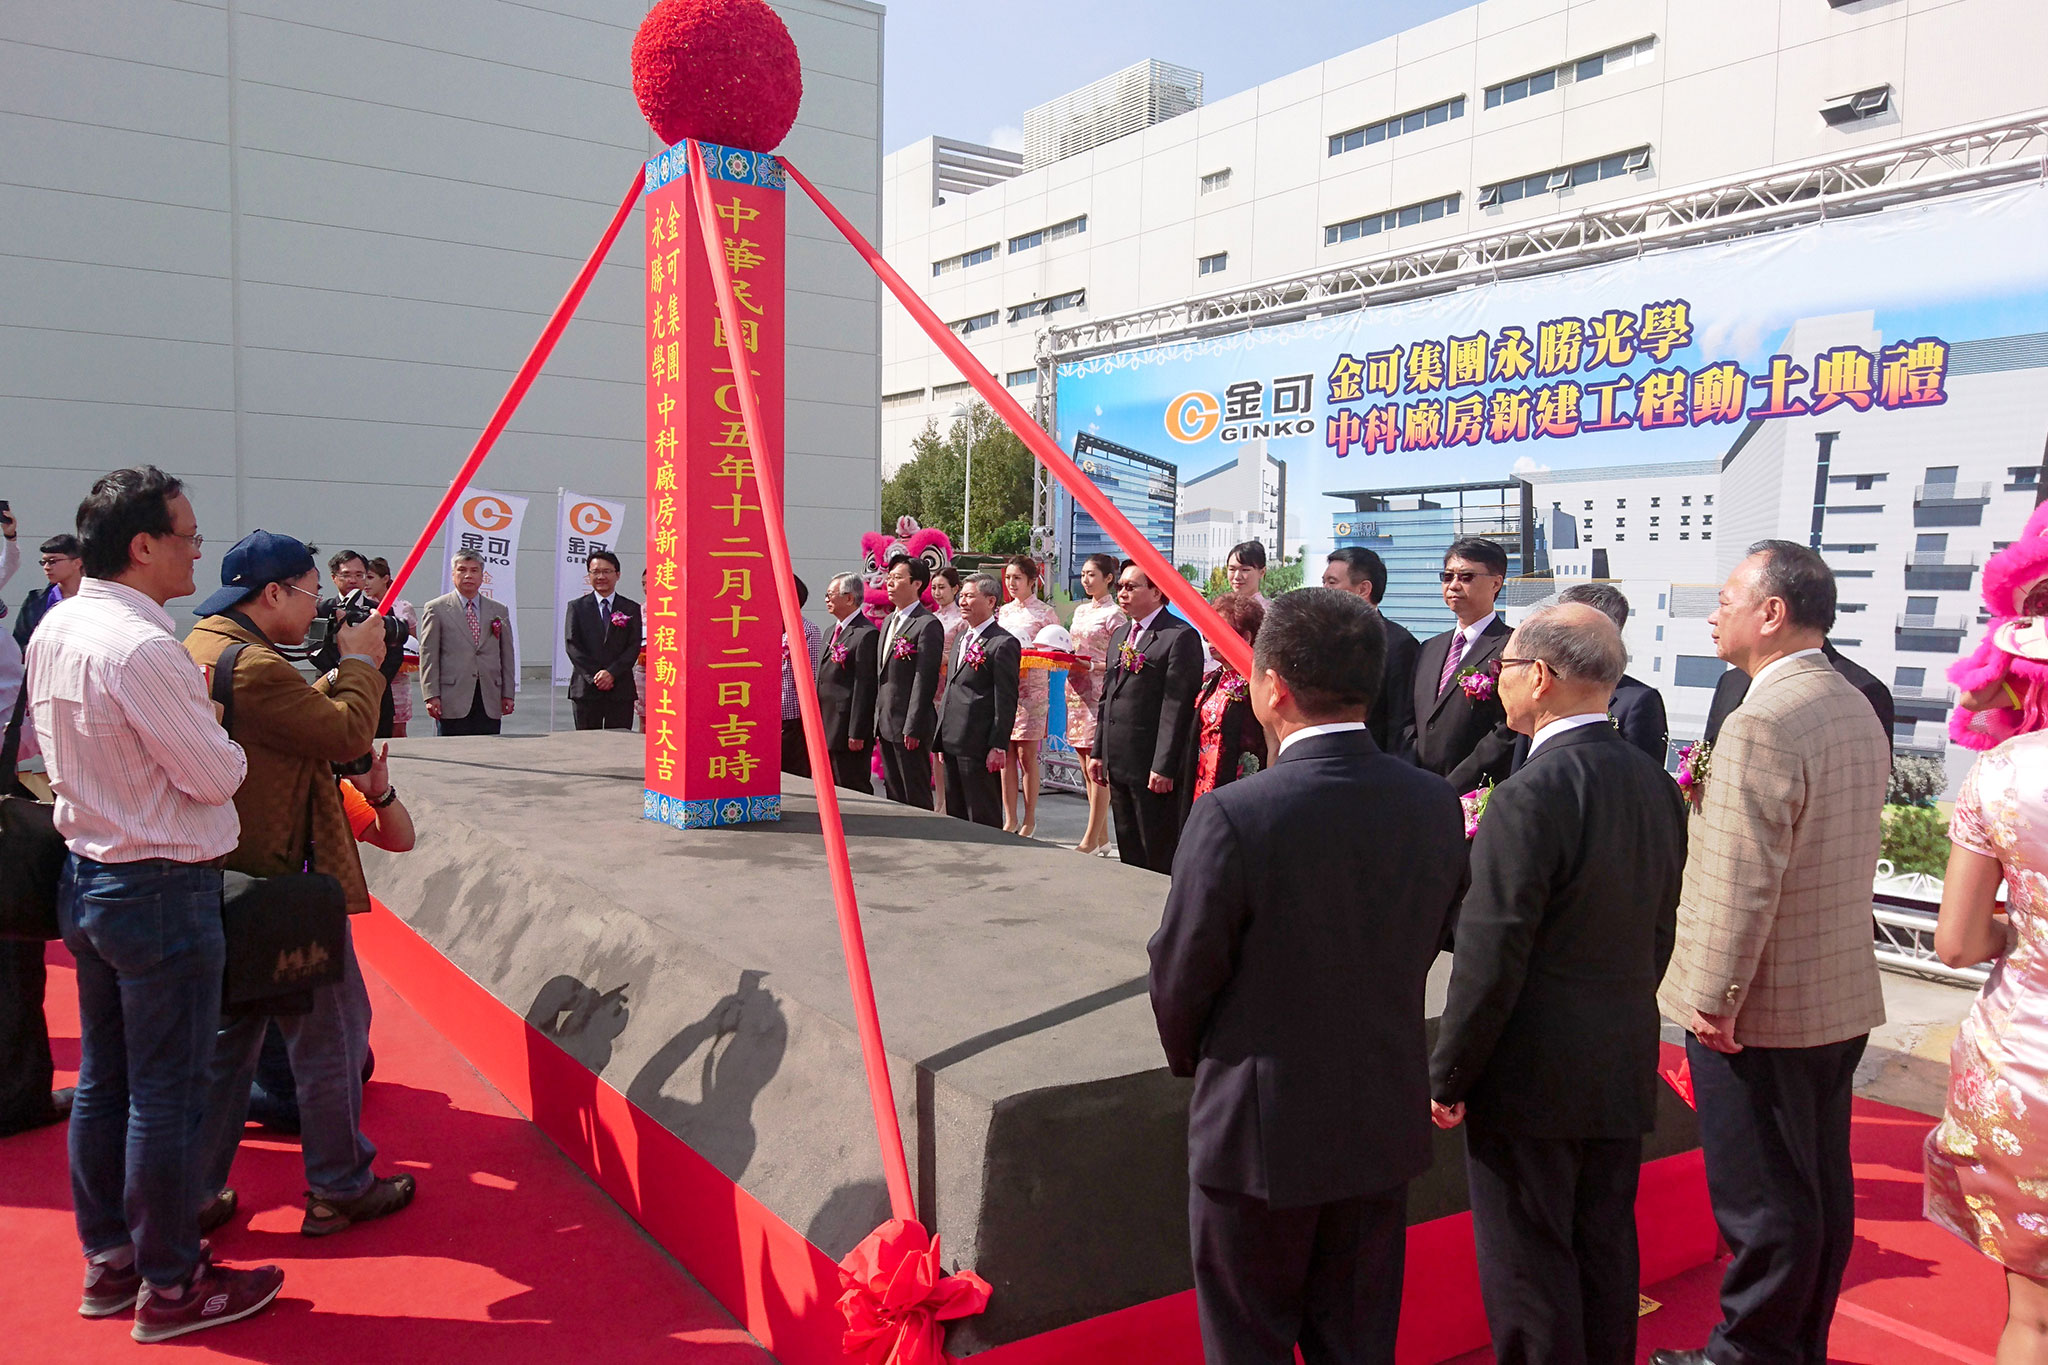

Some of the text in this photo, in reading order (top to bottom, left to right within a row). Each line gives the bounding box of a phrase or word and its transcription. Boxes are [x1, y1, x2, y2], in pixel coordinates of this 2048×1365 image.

[650, 208, 666, 388] 永勝光學
[666, 200, 681, 383] 金可集團
[1225, 374, 1314, 422] 金可
[1327, 337, 1949, 458] 中科廠房新建工程動土典禮
[1329, 299, 1692, 403] 金可集團永勝光學
[1221, 420, 1315, 441] GINKO
[461, 532, 511, 557] 金可
[654, 392, 680, 783] 中科廠房新建工程動土大吉
